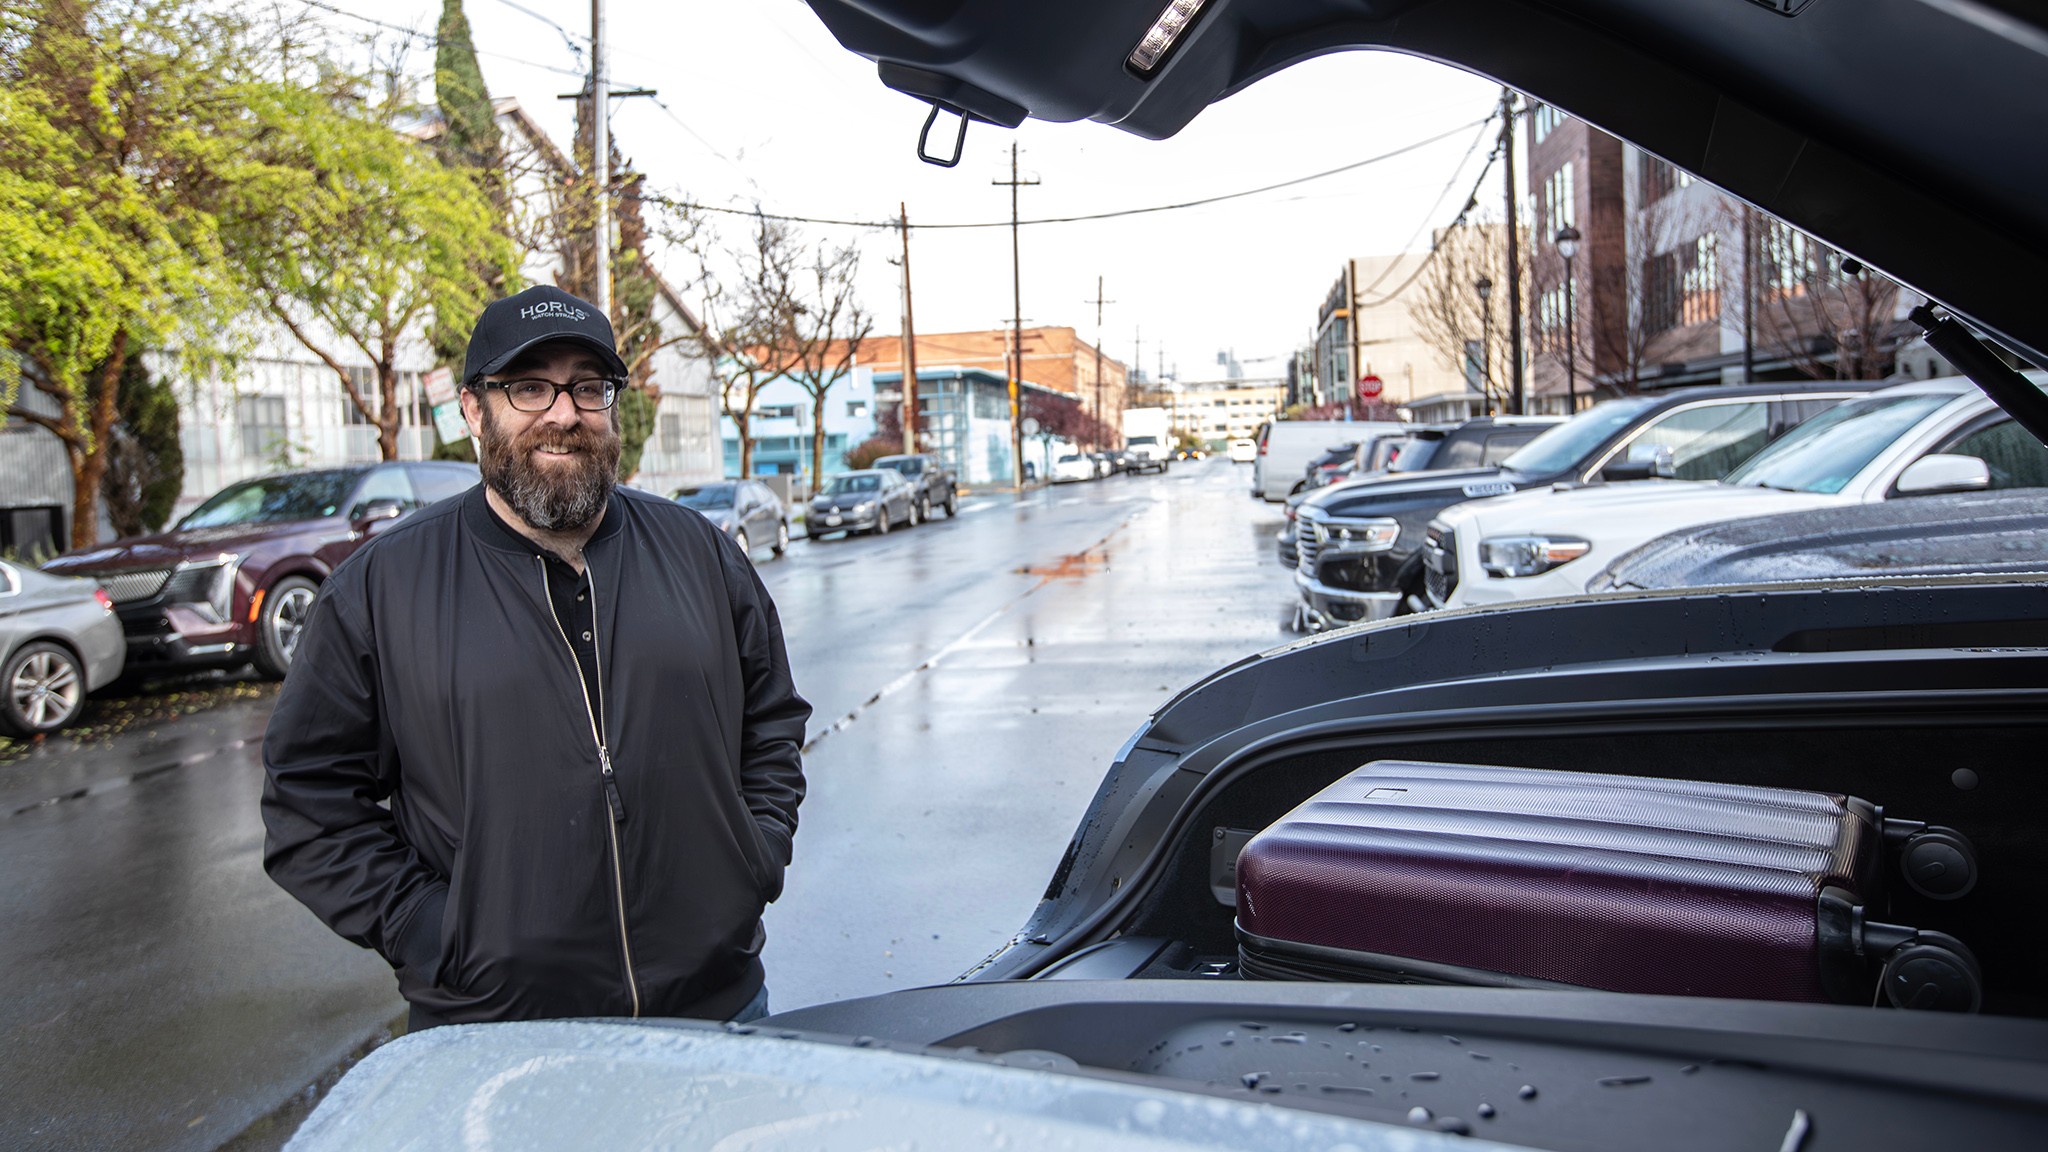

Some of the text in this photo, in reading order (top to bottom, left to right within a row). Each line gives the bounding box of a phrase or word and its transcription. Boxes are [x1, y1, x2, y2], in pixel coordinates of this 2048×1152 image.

[520, 301, 586, 320] HORUS
[531, 312, 579, 322] WATCH STRAPS
[1359, 380, 1381, 392] STOP
